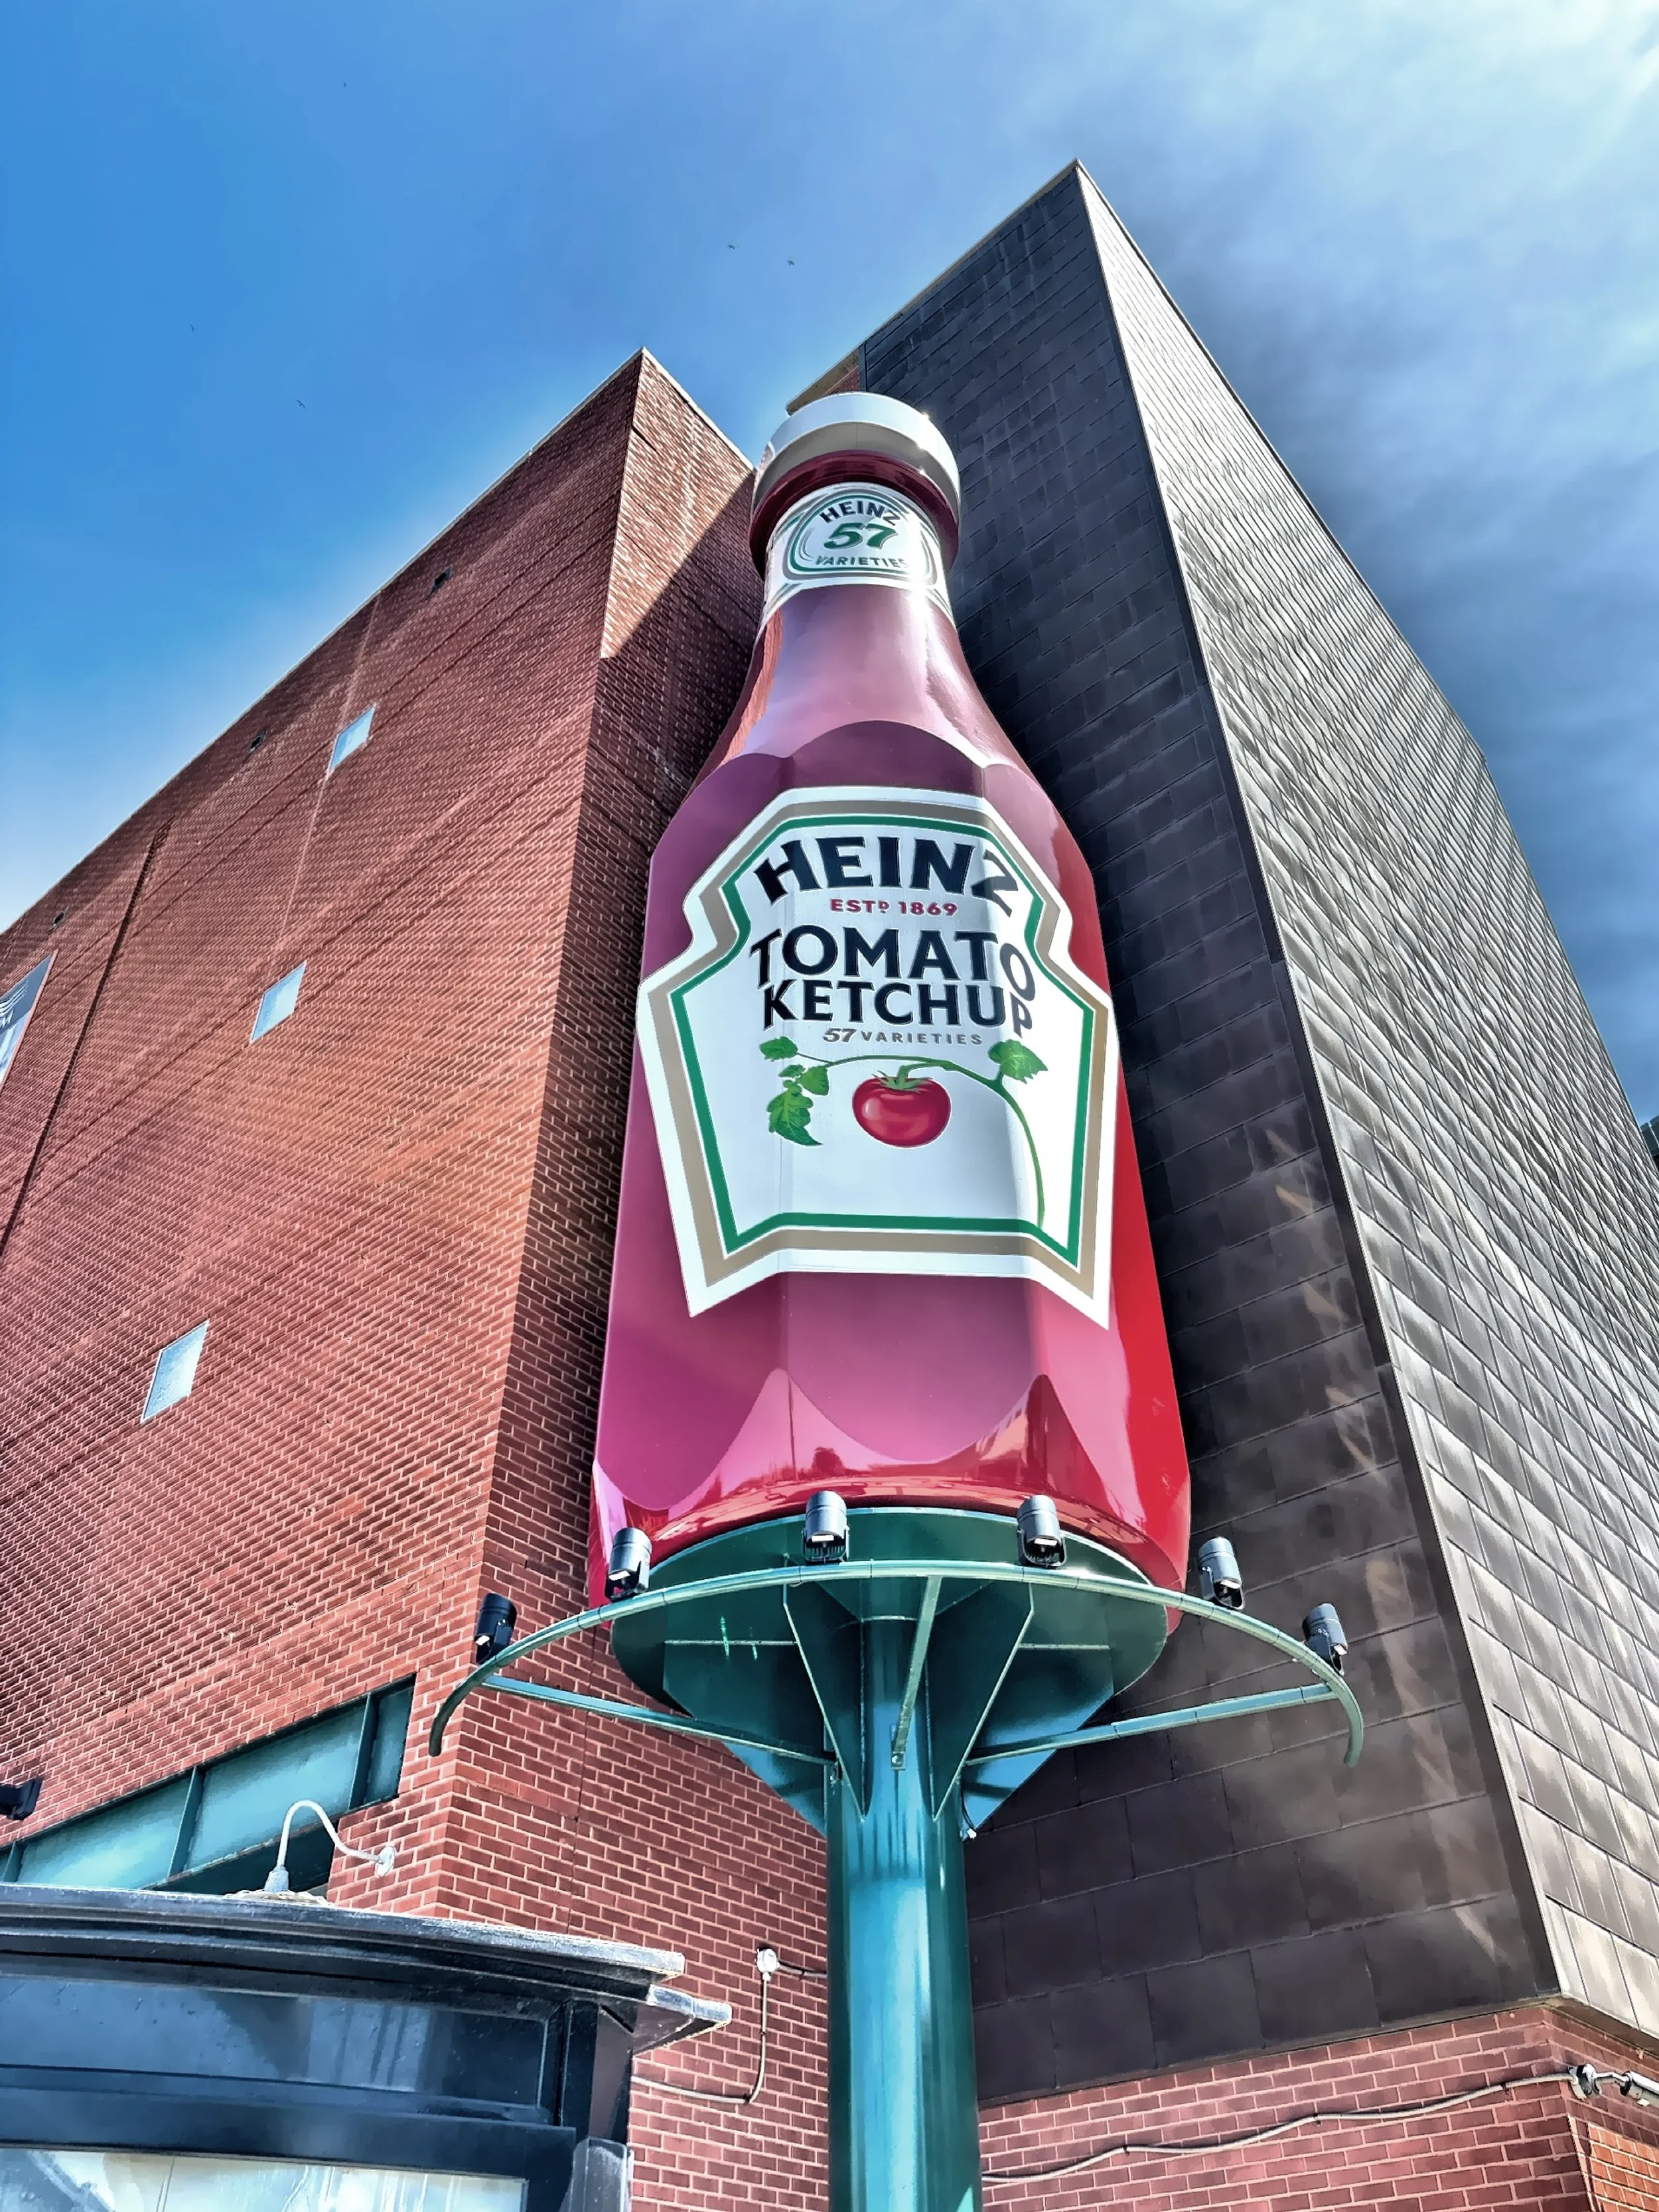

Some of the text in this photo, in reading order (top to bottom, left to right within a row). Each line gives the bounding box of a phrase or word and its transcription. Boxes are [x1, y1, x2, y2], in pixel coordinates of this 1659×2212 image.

[819, 500, 901, 526] HEINZ
[824, 522, 899, 550] 57
[815, 555, 910, 569] VARIETIES
[754, 836, 1019, 918] HEINZ
[898, 900, 958, 917] 1869
[750, 924, 1037, 1002] TOMATO
[762, 979, 1033, 1038] KETCHUP
[822, 1028, 983, 1046] 57 VARIETIES
